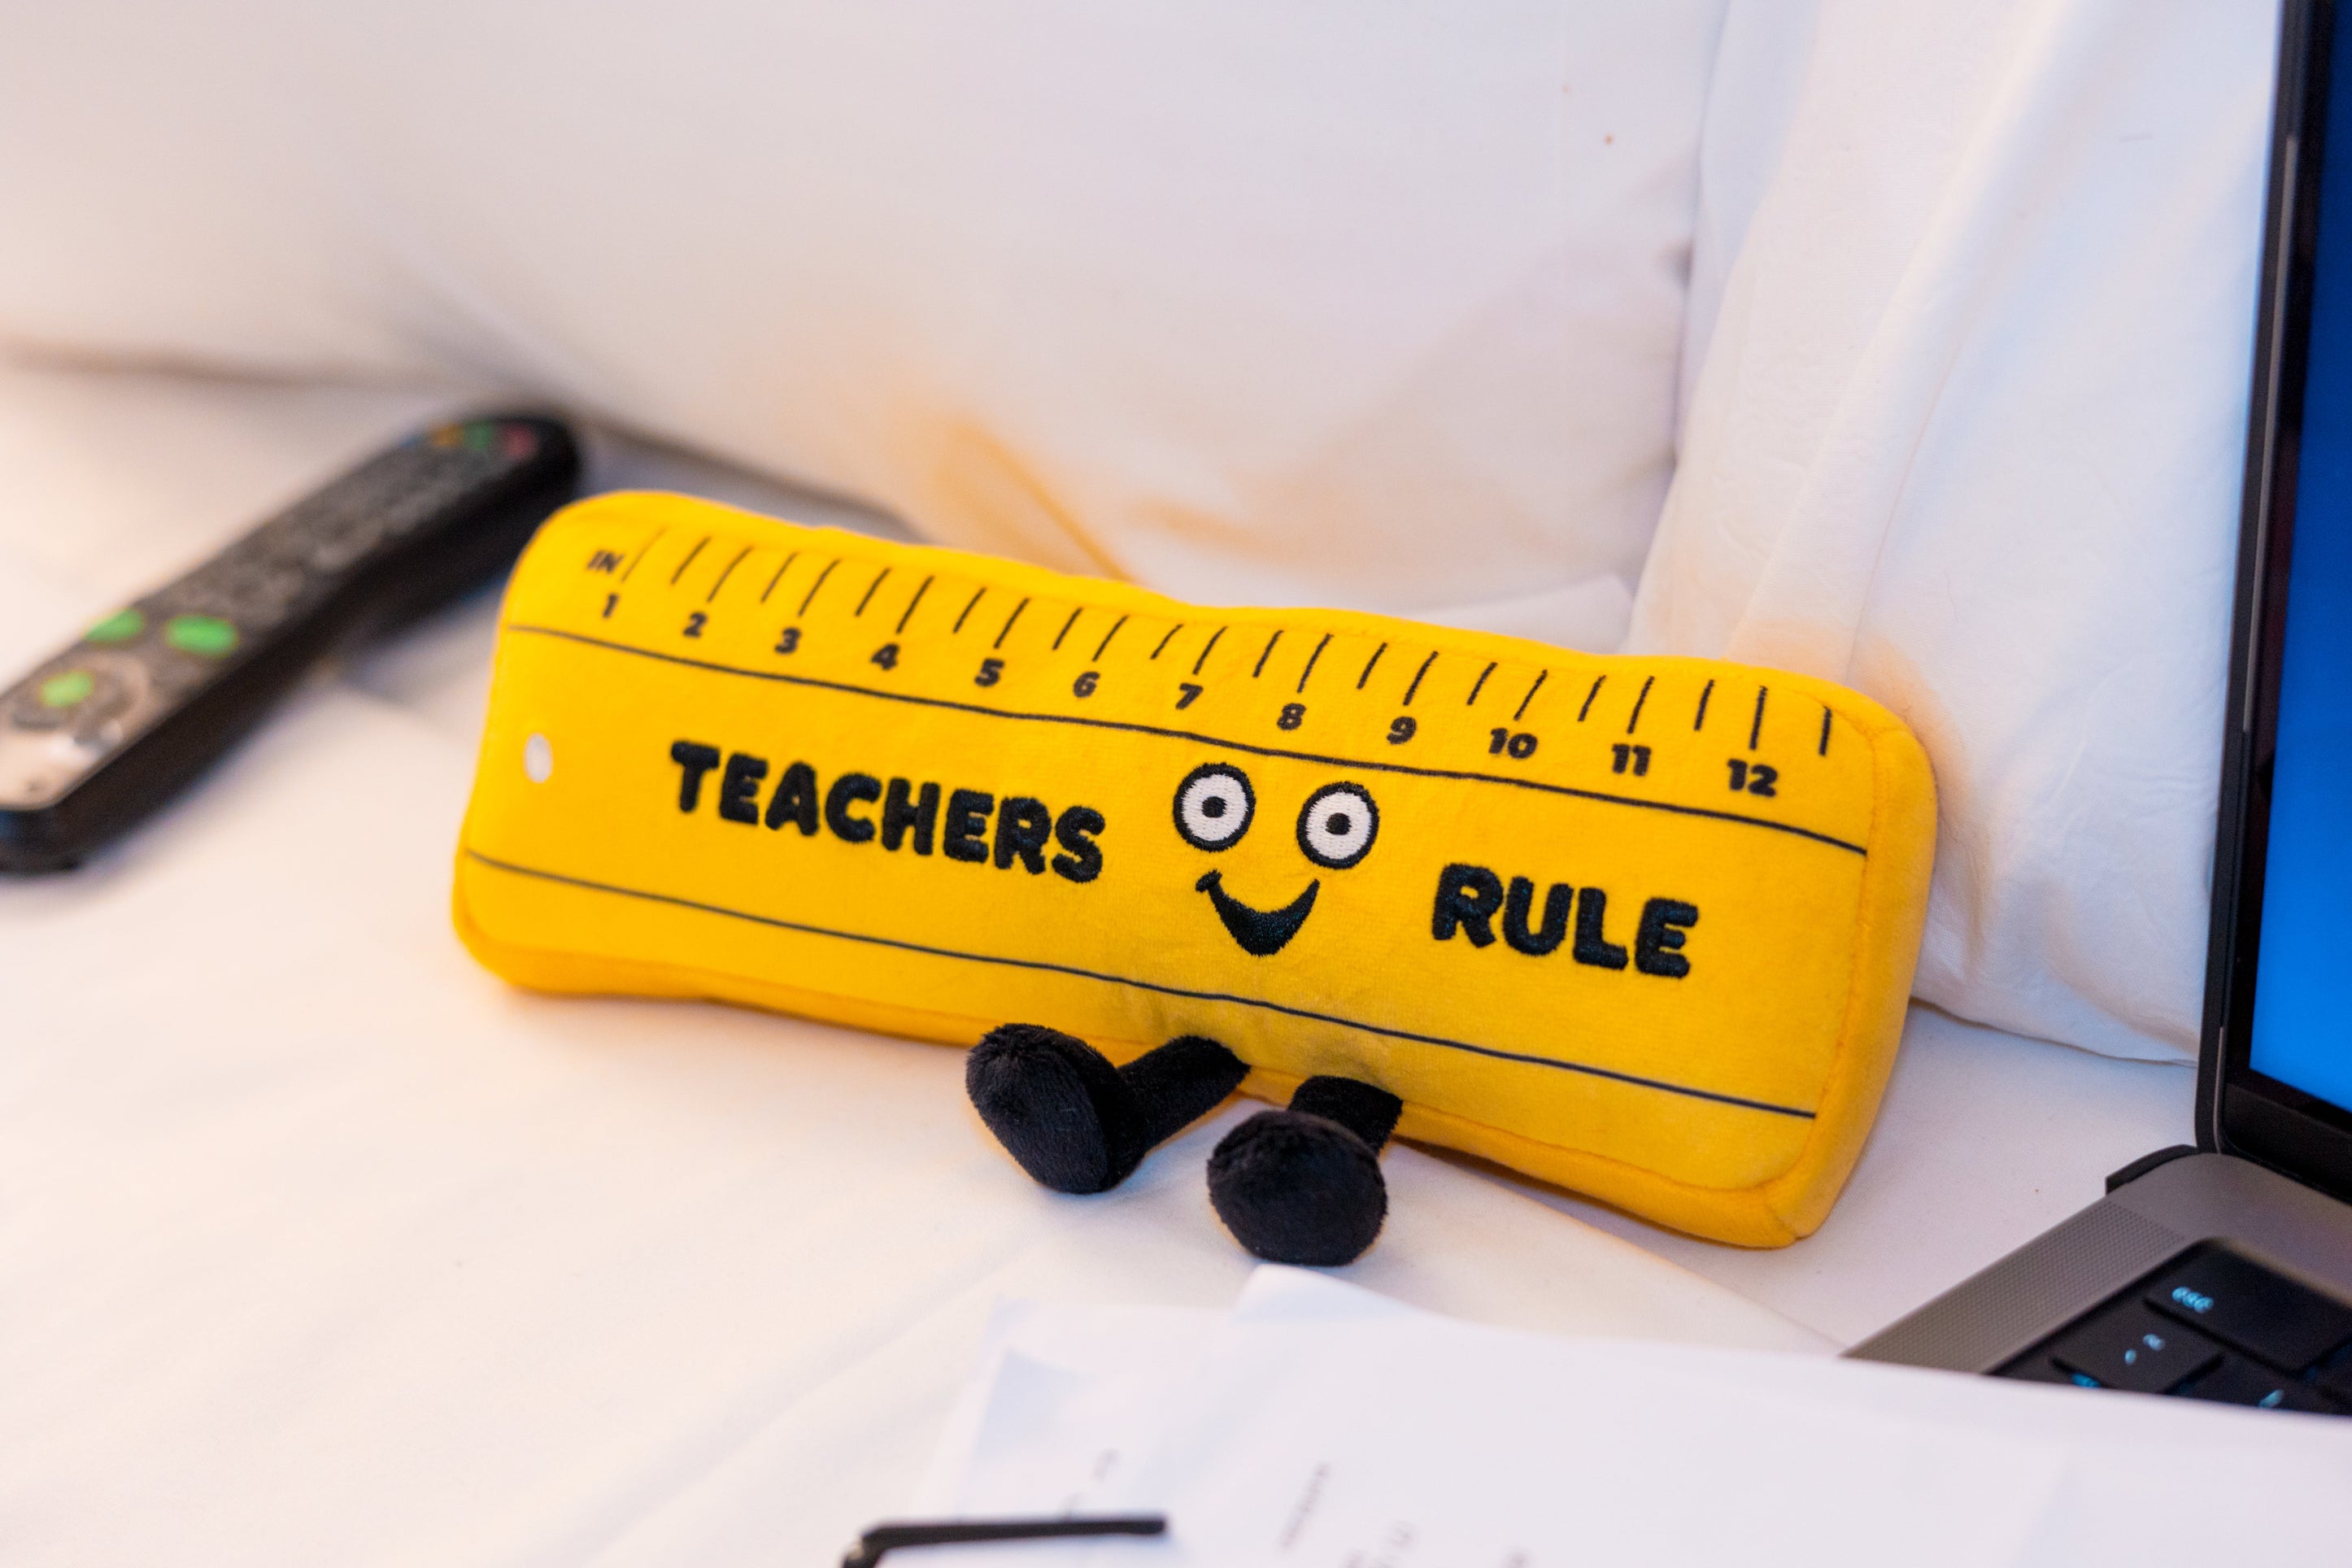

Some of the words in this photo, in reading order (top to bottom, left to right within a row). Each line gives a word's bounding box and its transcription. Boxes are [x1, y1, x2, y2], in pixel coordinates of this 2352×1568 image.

[586, 550, 625, 574] IN
[602, 592, 620, 619] 1
[682, 611, 708, 638] 2
[773, 627, 802, 655] 3
[869, 642, 900, 671] 4
[973, 657, 1005, 688] 5
[1072, 670, 1100, 699] 6
[1174, 682, 1204, 711] 7
[1275, 702, 1307, 732] 8
[1386, 715, 1418, 746] 9
[1487, 727, 1539, 760] 10
[1611, 743, 1653, 777] 11
[1726, 757, 1779, 799] 12
[669, 739, 1107, 884] TEACHERS
[1430, 861, 1700, 981] RULE
